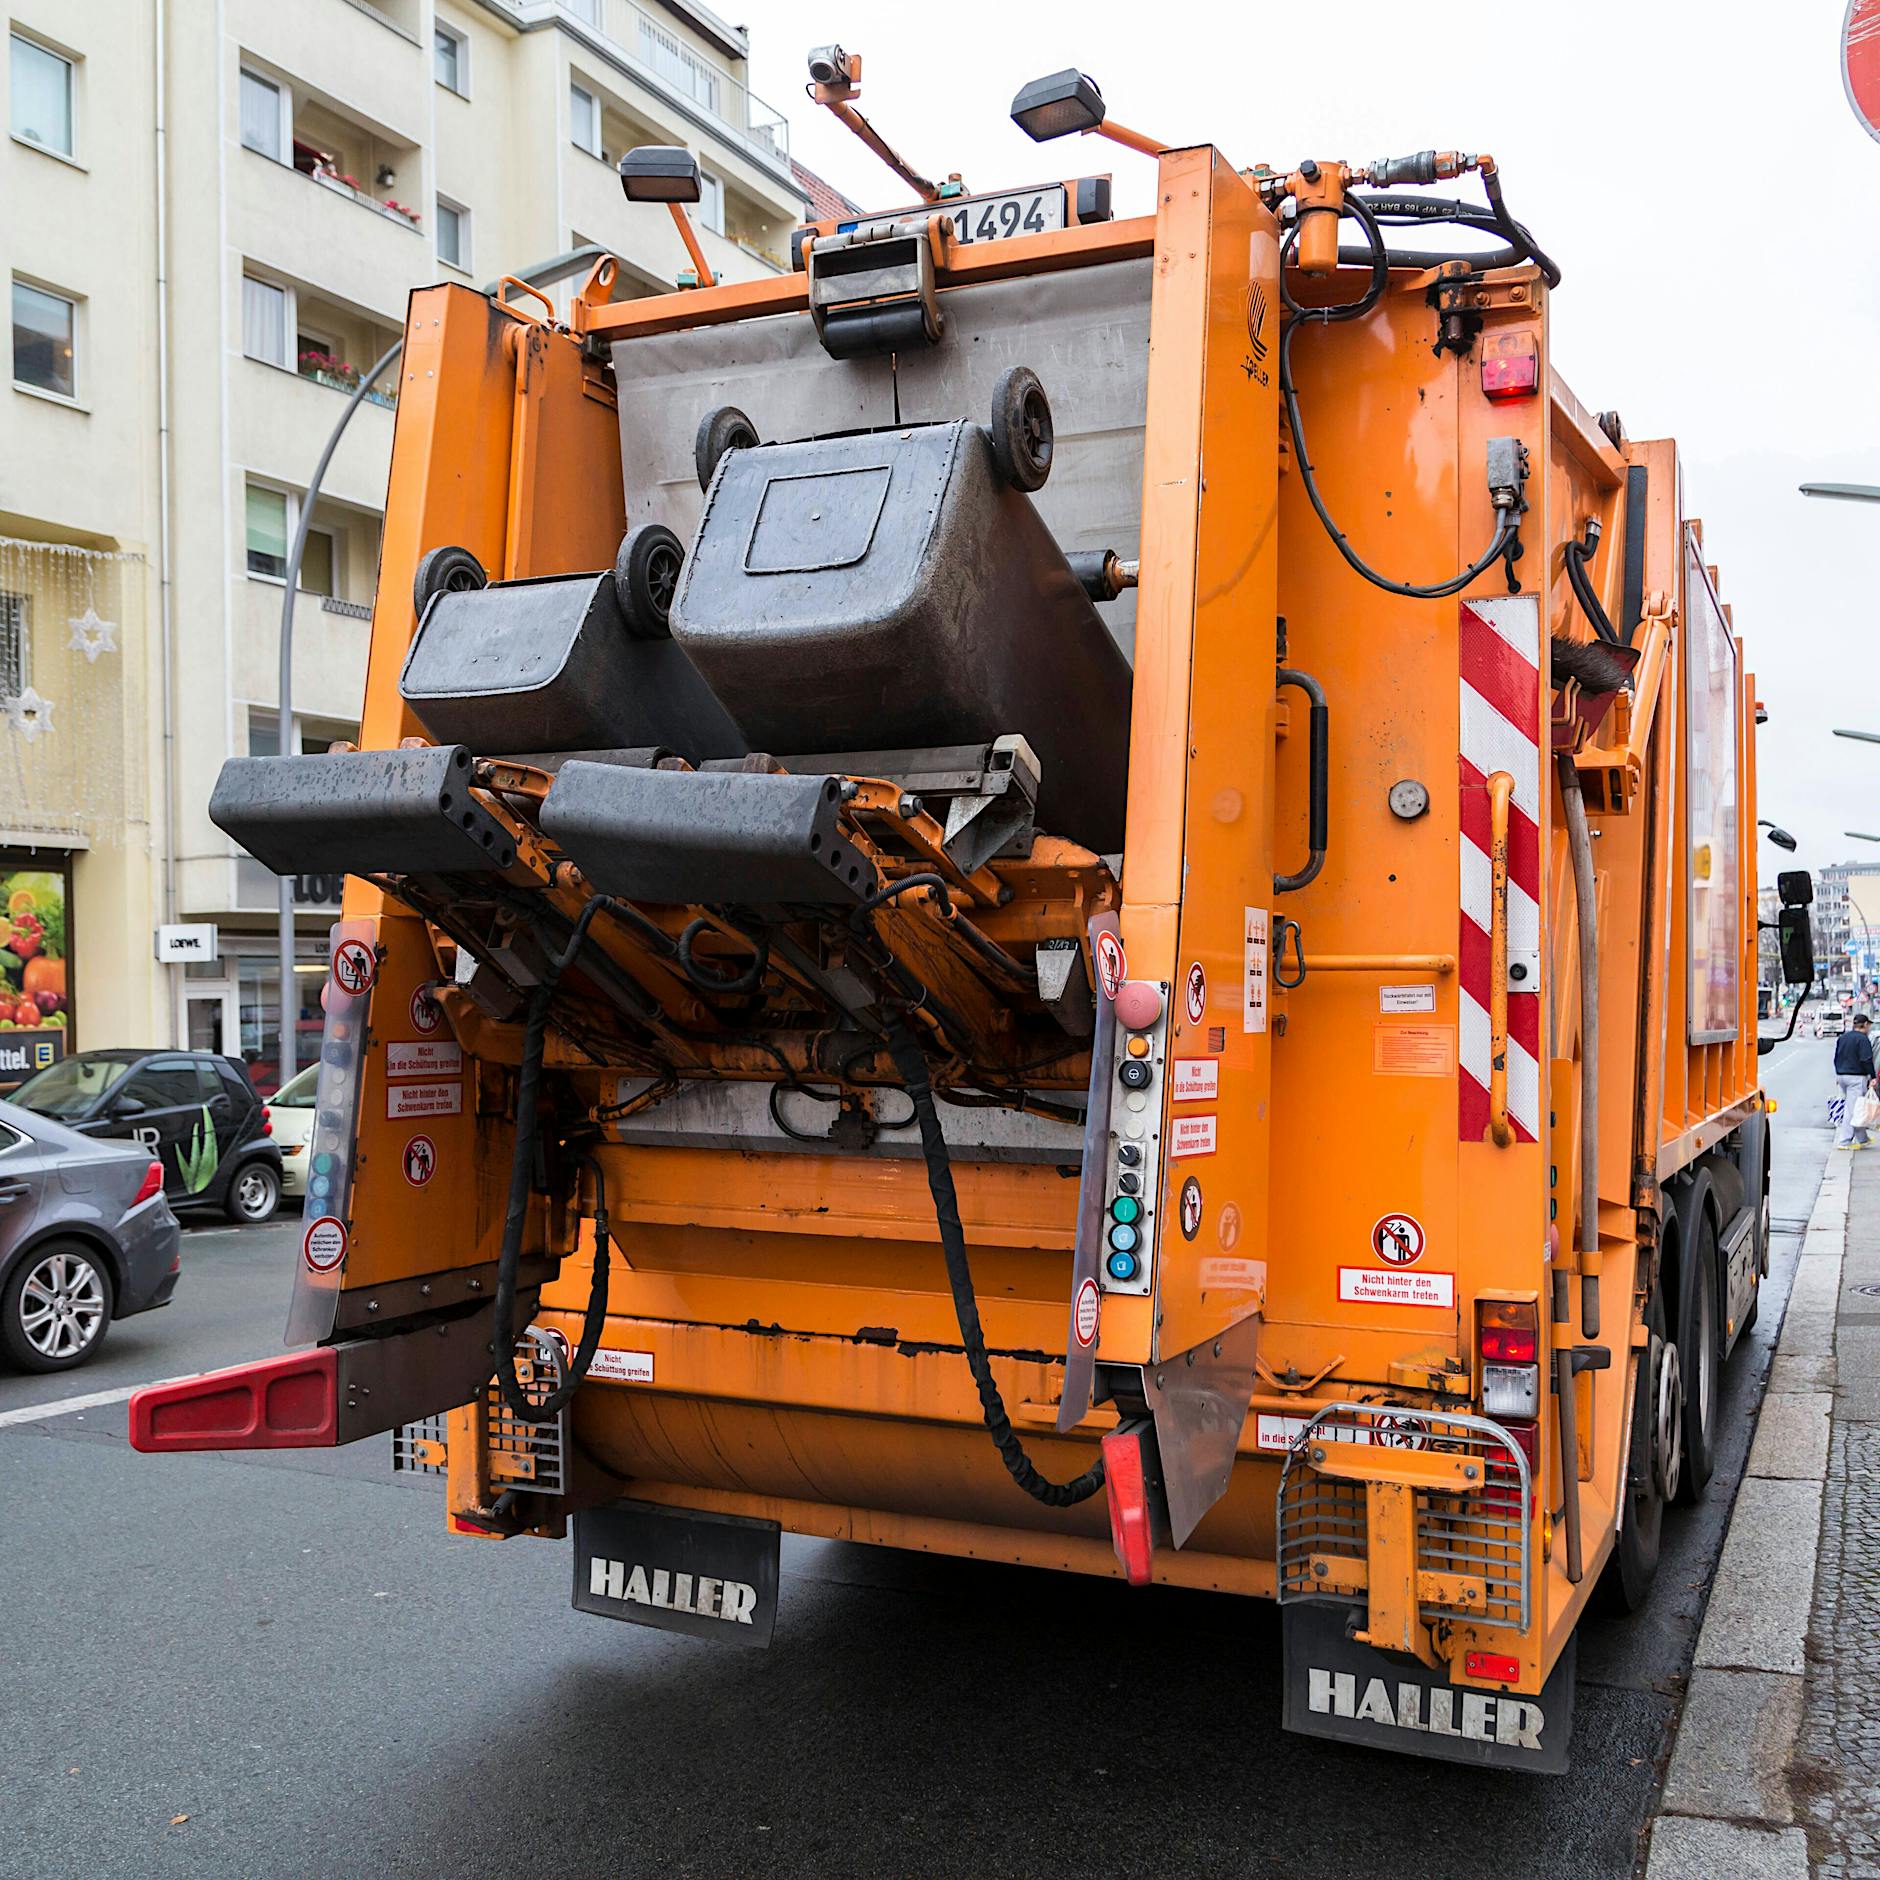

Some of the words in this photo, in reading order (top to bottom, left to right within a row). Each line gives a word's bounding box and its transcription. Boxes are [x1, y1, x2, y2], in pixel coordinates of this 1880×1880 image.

[1380, 203, 1401, 212] BAR
[1404, 203, 1419, 212] 165
[1422, 206, 1437, 214] WP
[954, 196, 1045, 245] 1494
[417, 1047, 434, 1057] Nicht
[397, 1060, 407, 1070] die
[402, 1089, 418, 1100] Nicht
[1362, 1273, 1384, 1285] Nicht
[1387, 1275, 1412, 1286] hinter
[1415, 1277, 1432, 1288] den
[1354, 1286, 1409, 1299] Schwenkarm
[1412, 1289, 1439, 1301] treten
[604, 1354, 622, 1364] Nicht
[594, 1363, 626, 1376] Schüttung
[627, 1367, 650, 1377] greifen
[1262, 1433, 1270, 1443] in
[1272, 1434, 1286, 1444] die
[589, 1556, 757, 1625] HALLER
[1308, 1667, 1545, 1750] HALLER
